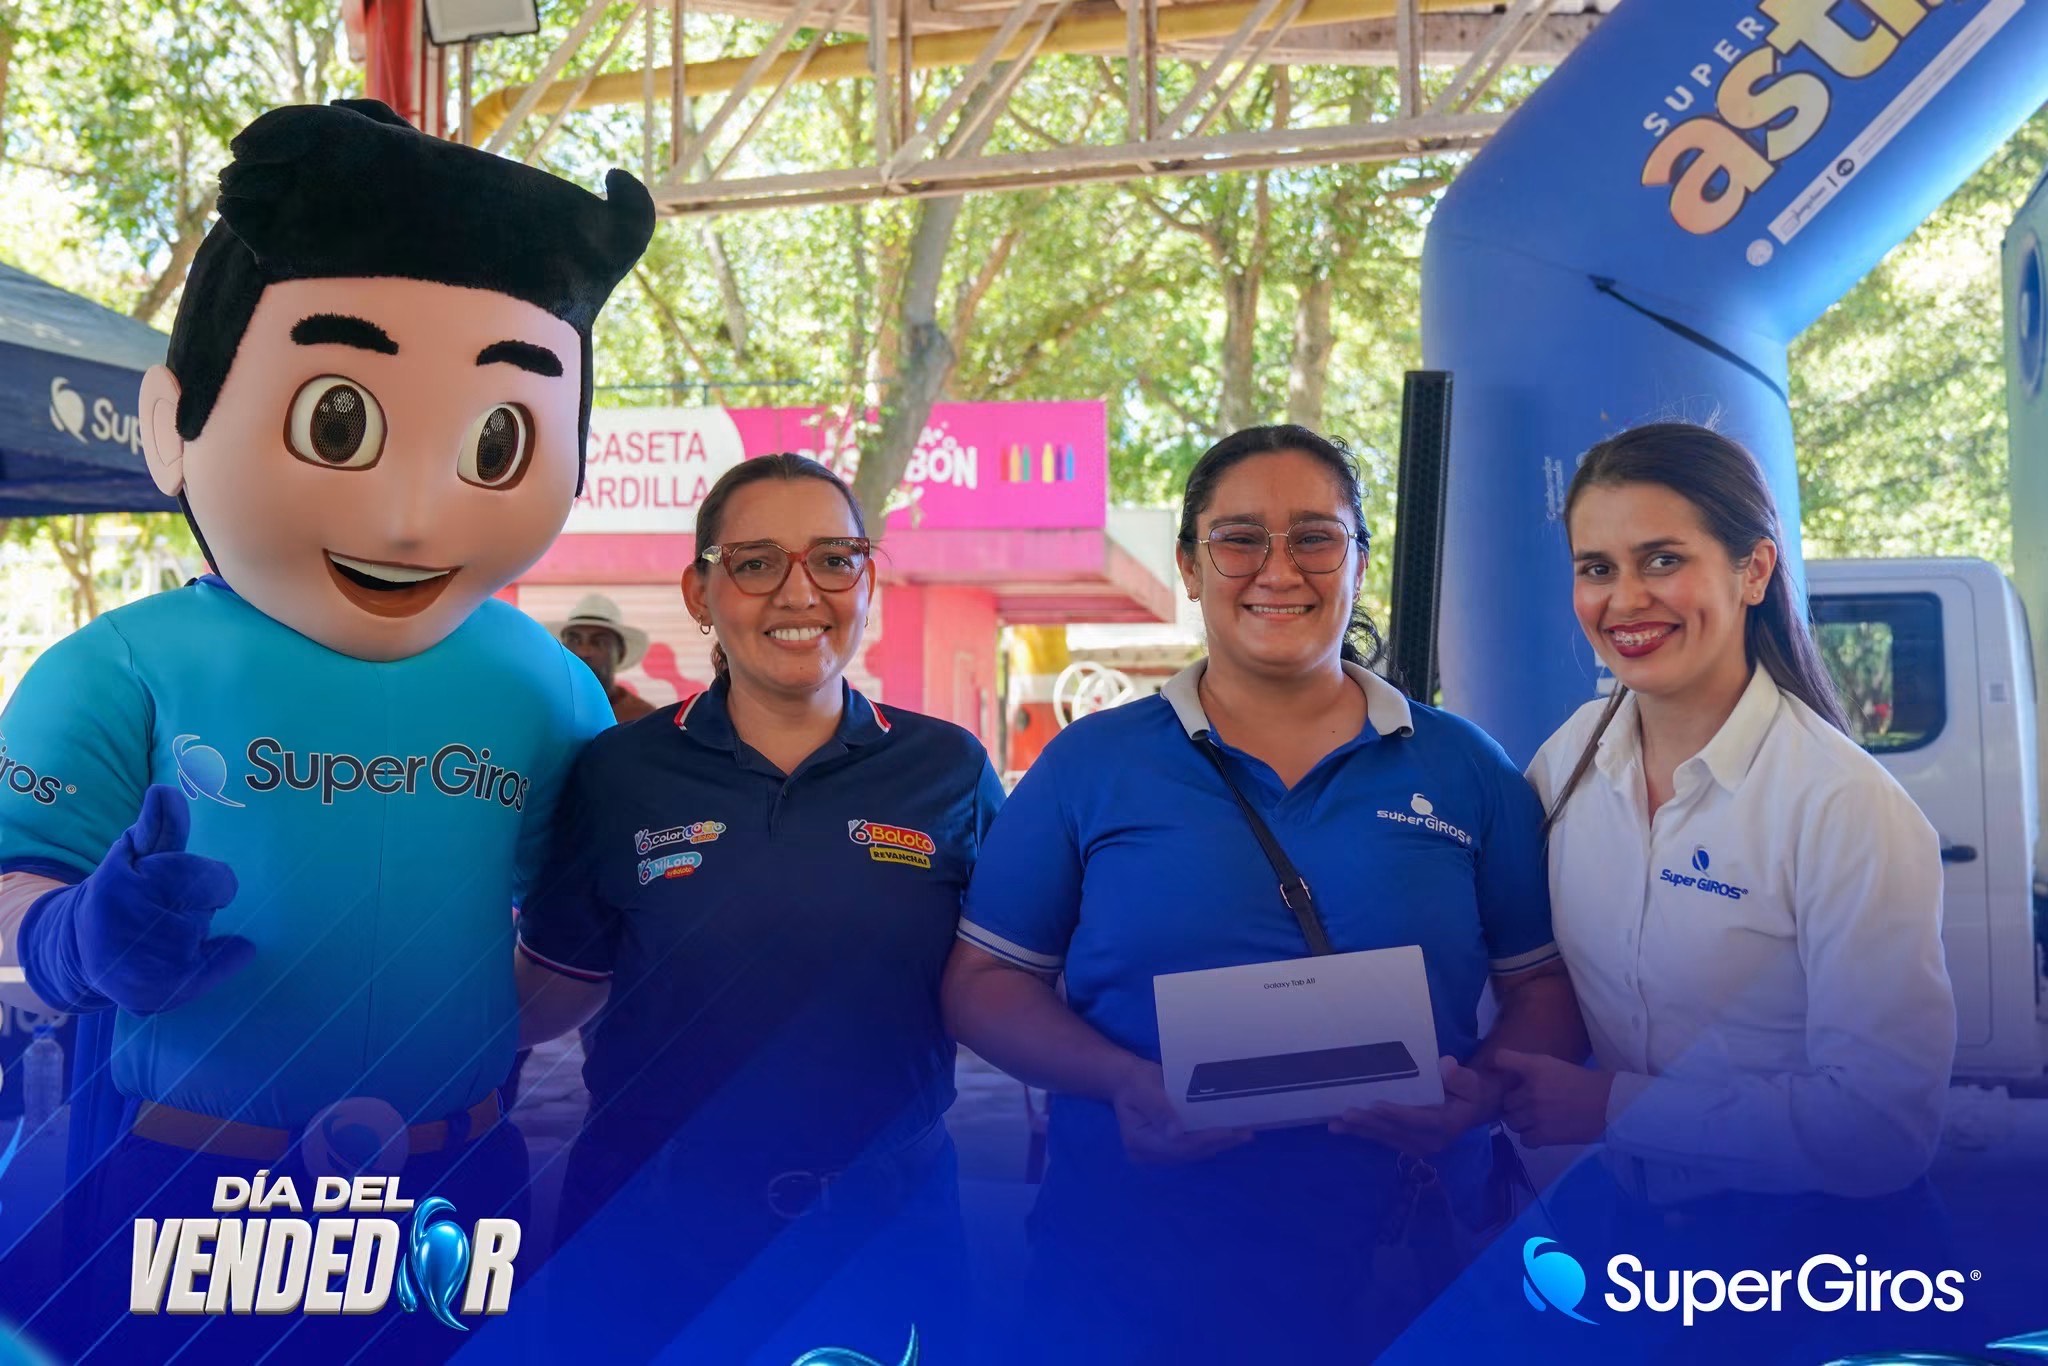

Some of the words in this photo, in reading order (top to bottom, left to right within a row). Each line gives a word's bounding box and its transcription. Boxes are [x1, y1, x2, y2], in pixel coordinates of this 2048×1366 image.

[1643, 15, 1765, 137] SUPER
[1642, 0, 1946, 235] ast
[586, 430, 707, 464] CASETA
[575, 475, 711, 509] ARDILLA
[872, 826, 933, 851] Baloto
[1263, 982, 1290, 990] Galaxy
[1291, 979, 1305, 987] Tab
